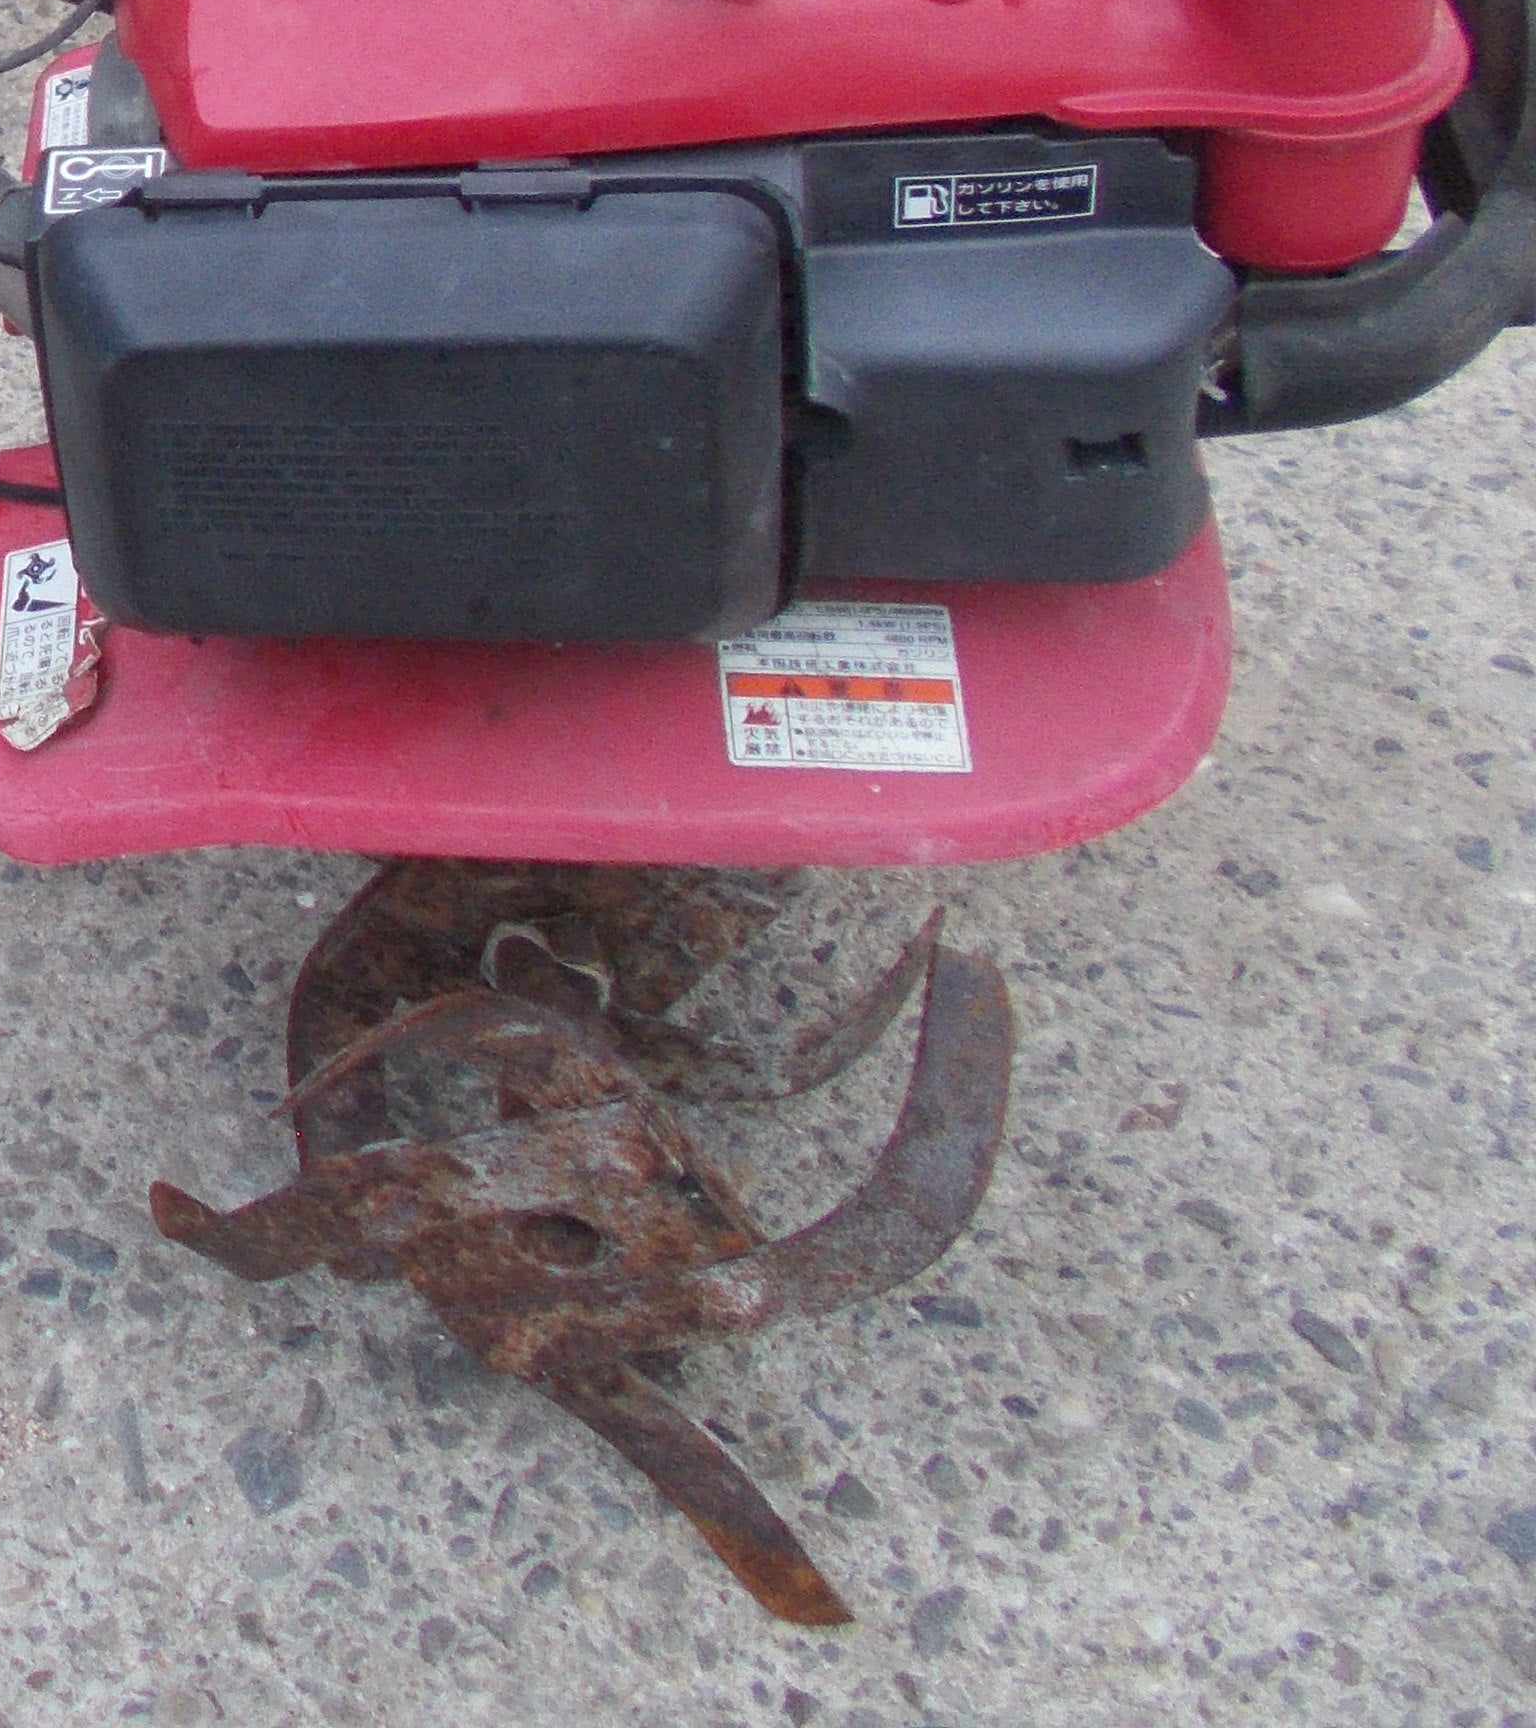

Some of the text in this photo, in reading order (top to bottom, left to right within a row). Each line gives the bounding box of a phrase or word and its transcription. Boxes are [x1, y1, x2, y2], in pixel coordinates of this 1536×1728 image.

[957, 174, 1089, 195] ガソリンを使用
